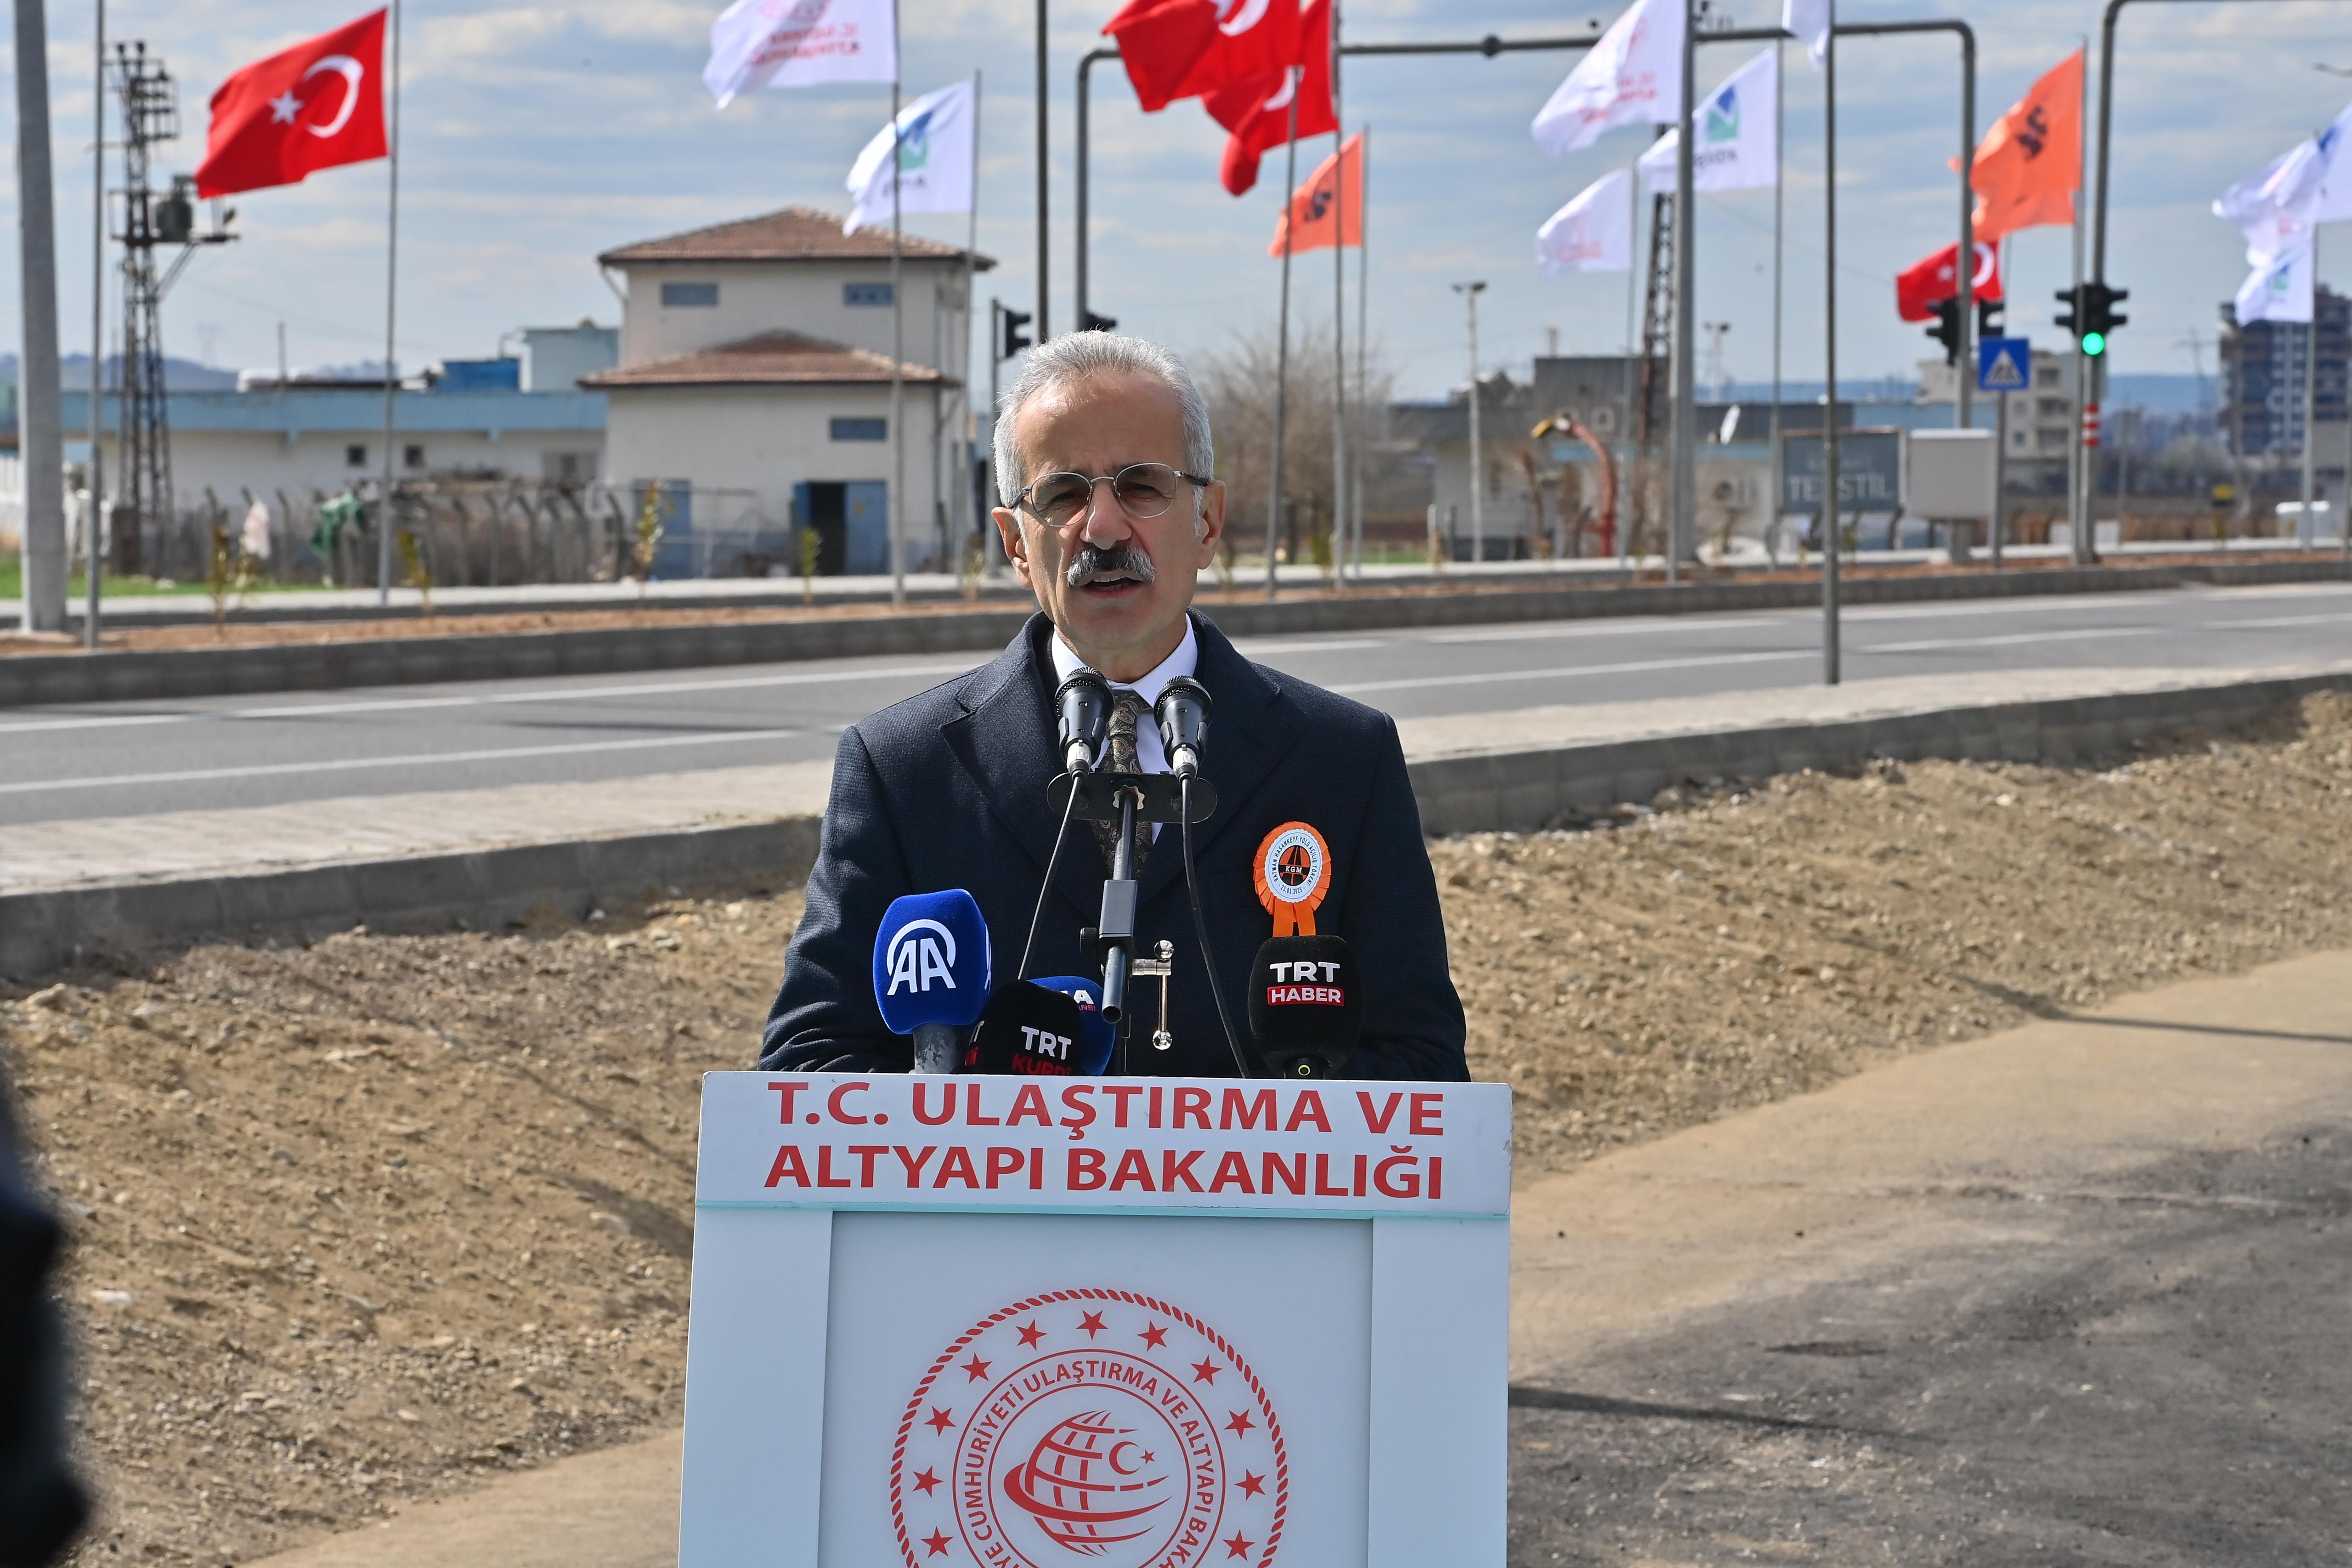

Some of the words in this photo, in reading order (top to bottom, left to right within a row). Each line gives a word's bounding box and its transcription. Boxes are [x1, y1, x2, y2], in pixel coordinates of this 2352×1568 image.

[1274, 836, 1298, 857] HASANKEYF
[1300, 837, 1311, 847] YOLU
[1309, 846, 1317, 863] AÇILIŞ
[1280, 885, 1302, 894] 23.03.2025
[887, 938, 956, 996] AA
[1270, 962, 1340, 983] TRT
[1272, 988, 1341, 1003] HABER
[1021, 1026, 1072, 1060] TRT
[768, 1082, 888, 1125] T.C.
[912, 1083, 1332, 1140] ULAŞTIRMA
[1356, 1092, 1443, 1136] VE
[764, 1145, 1043, 1190] ALTYAPI
[1067, 1145, 1442, 1199] BAKANLIĞI
[965, 1383, 1024, 1540] CUMHURİYETİ
[1023, 1360, 1158, 1396] ULAŞTIRMA
[1161, 1388, 1189, 1419] VE
[1180, 1420, 1215, 1513] ALTYAPI
